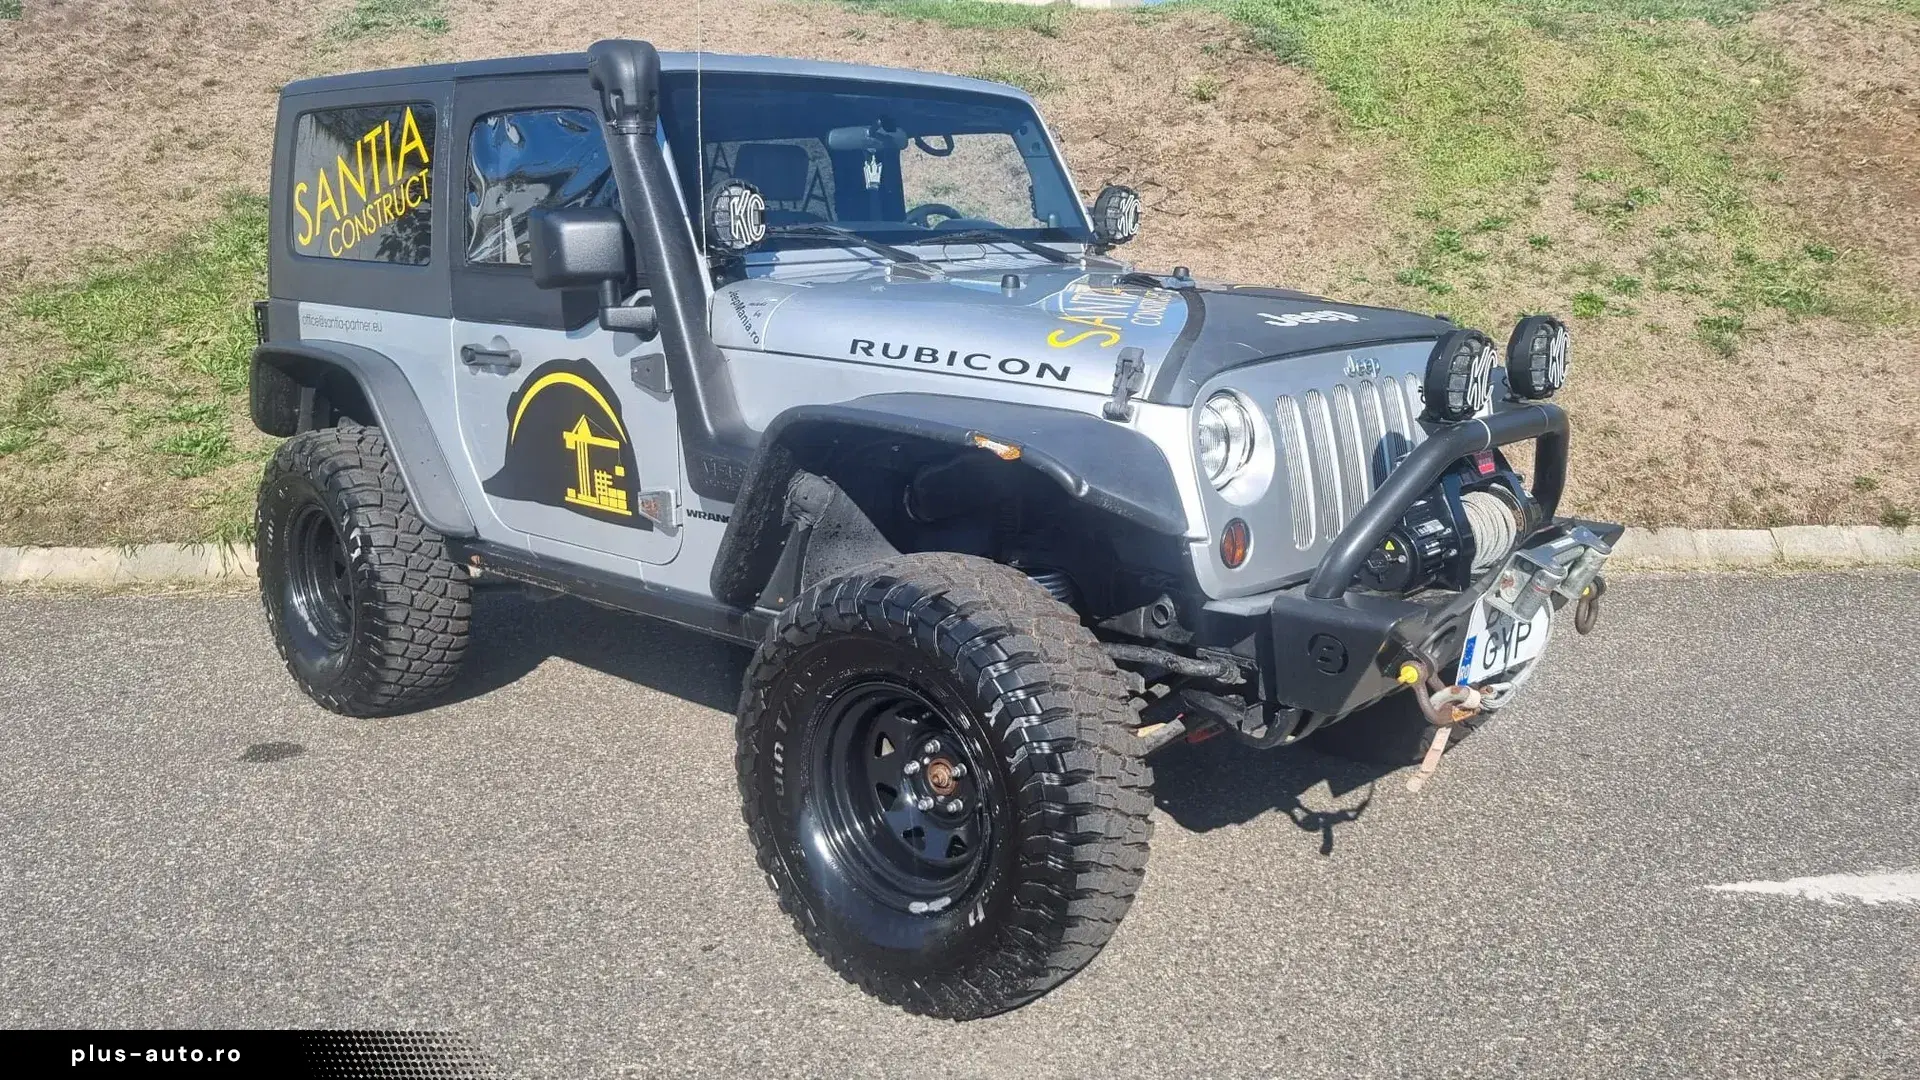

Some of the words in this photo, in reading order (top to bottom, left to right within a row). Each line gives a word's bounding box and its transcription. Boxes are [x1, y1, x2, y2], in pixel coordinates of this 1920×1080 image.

[294, 106, 430, 246] SANTIA
[328, 169, 430, 258] CONSTRUCT
[730, 189, 766, 246] KC
[1117, 194, 1141, 237] KC
[1256, 310, 1360, 327] Jeep
[850, 338, 1071, 383] RUBICON
[1343, 355, 1381, 378] Jeep
[1467, 346, 1498, 411] KC
[1482, 620, 1532, 670] GYP
